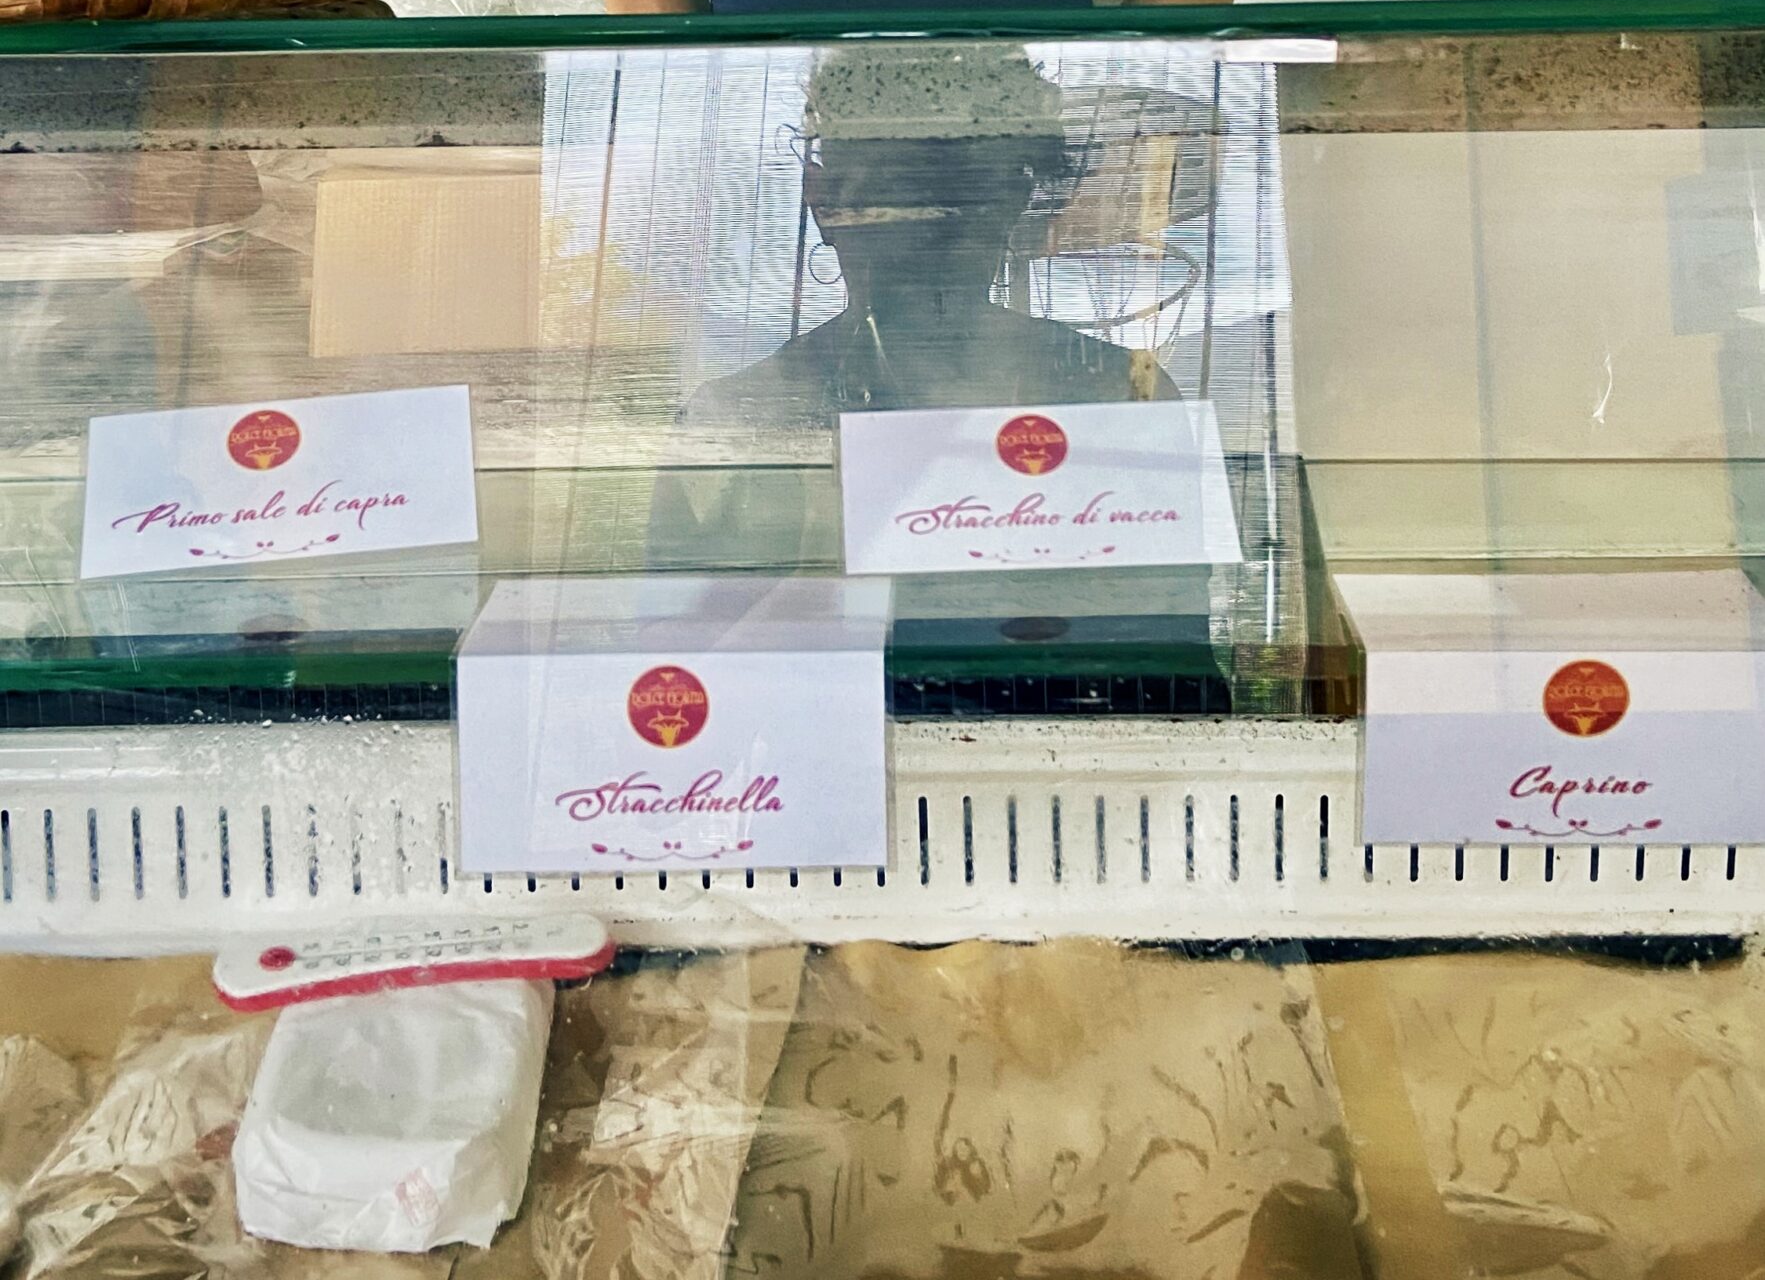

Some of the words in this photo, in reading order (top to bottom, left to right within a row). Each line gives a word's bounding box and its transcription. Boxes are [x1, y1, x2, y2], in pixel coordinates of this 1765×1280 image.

[111, 501, 228, 534] Primo
[230, 489, 286, 524] sale
[297, 479, 344, 516] di
[333, 492, 410, 531] capra
[895, 492, 1063, 536] Stracchino
[1073, 490, 1116, 525] di
[1109, 507, 1180, 524] vacca
[555, 768, 785, 822] Stracchinella
[1508, 764, 1654, 818] Caprino
